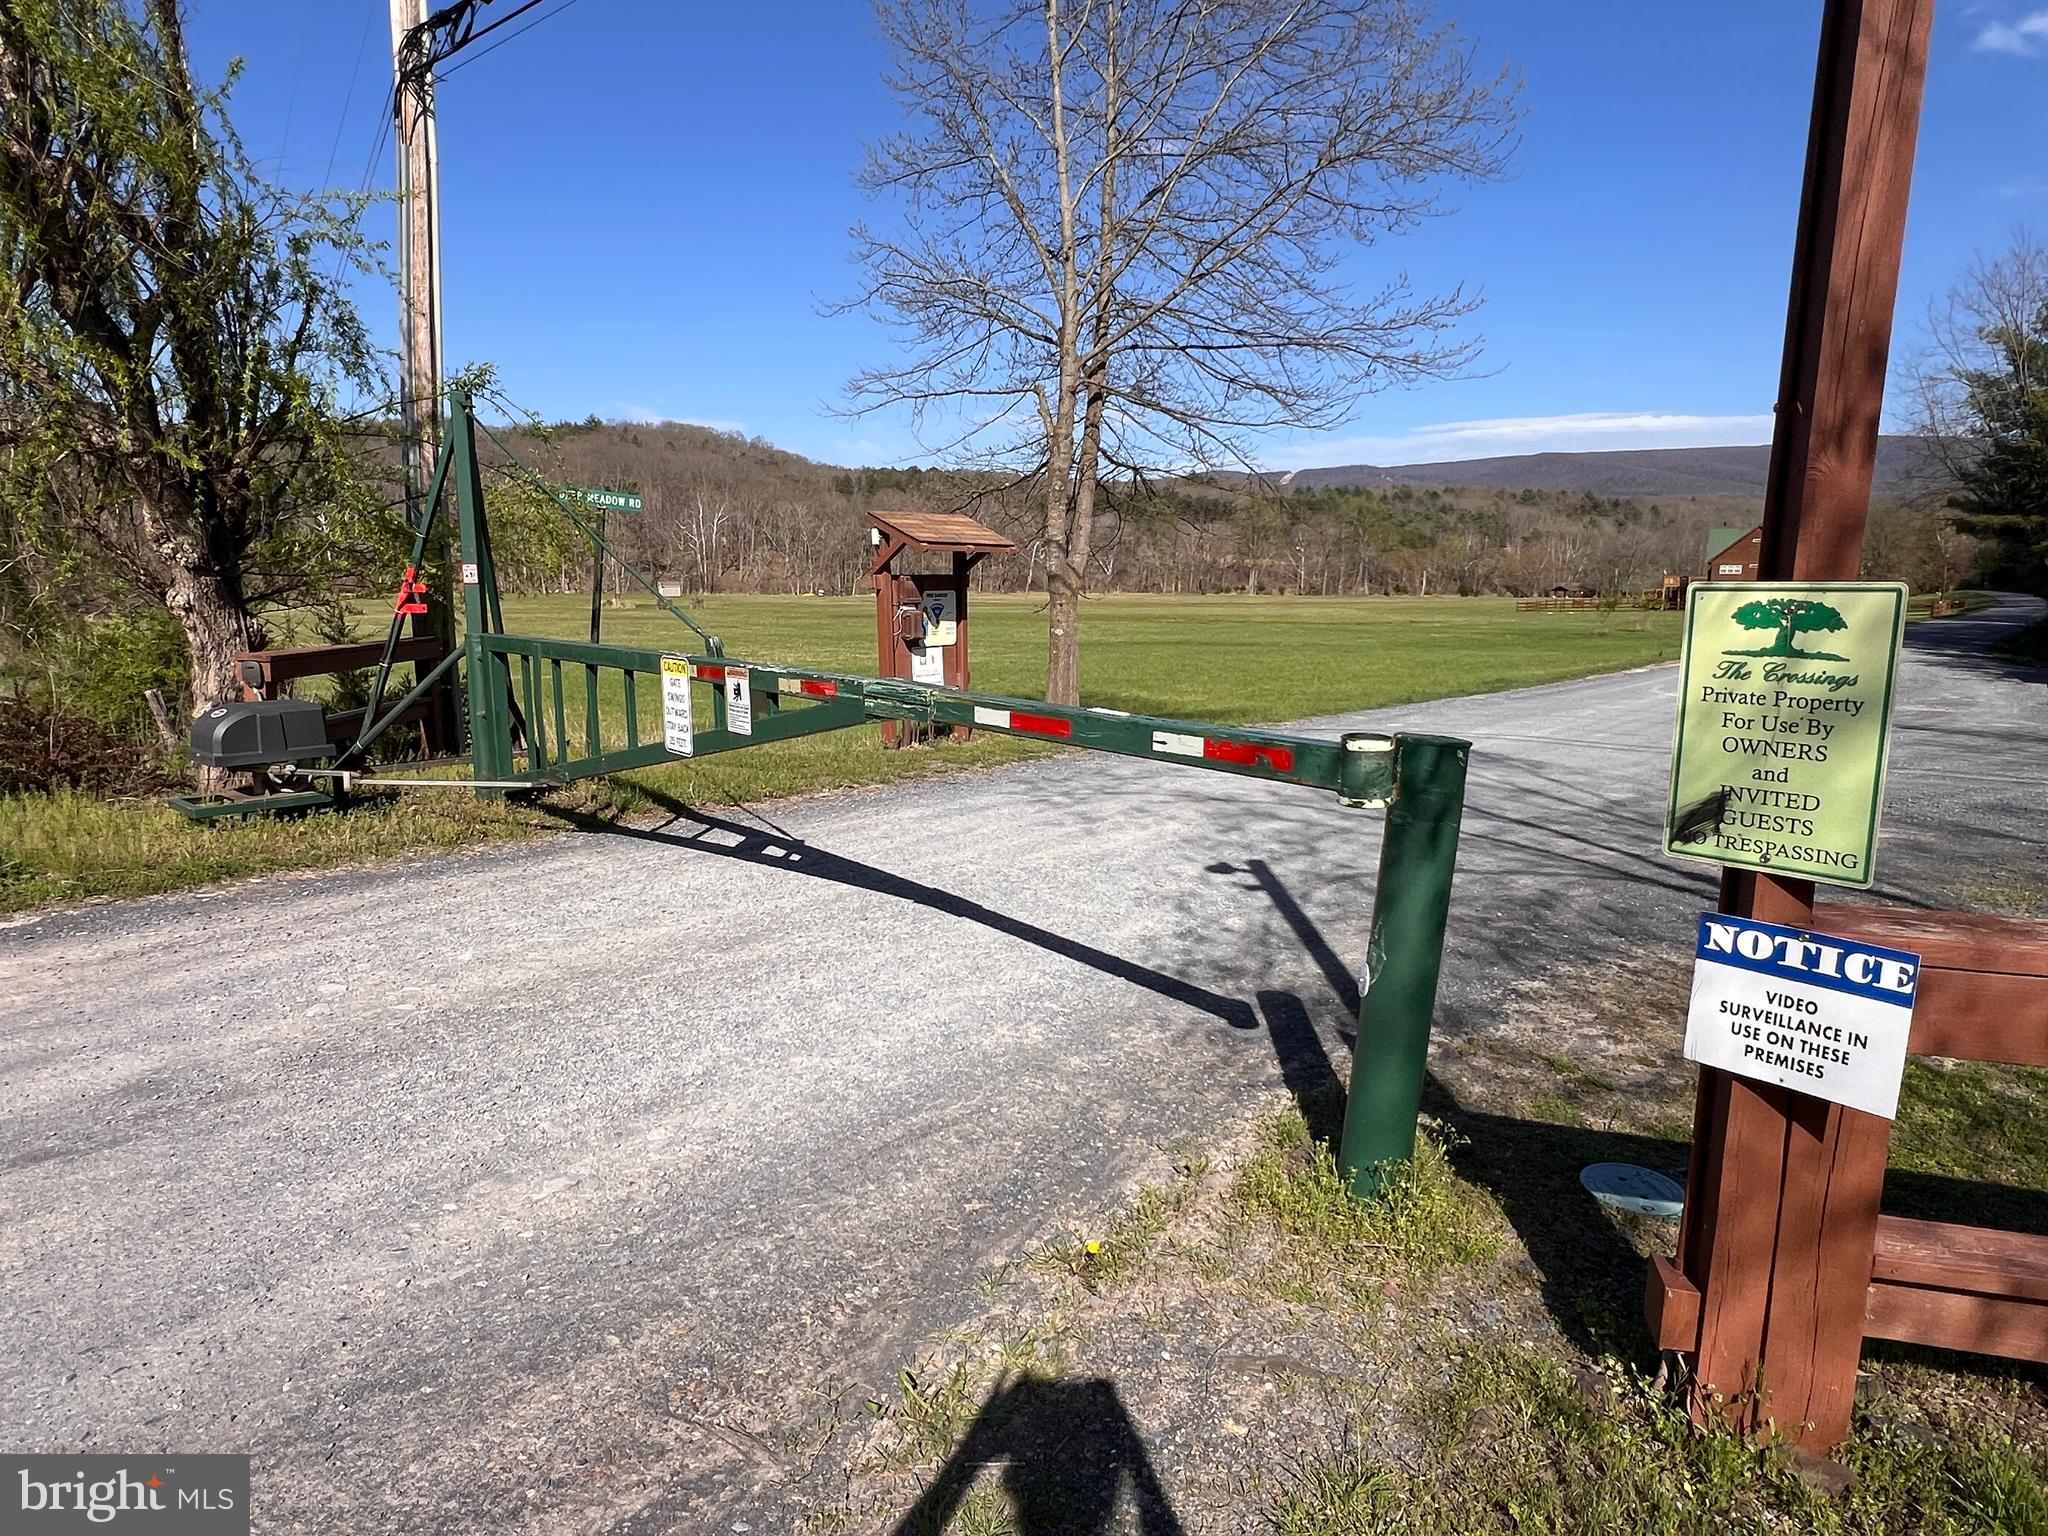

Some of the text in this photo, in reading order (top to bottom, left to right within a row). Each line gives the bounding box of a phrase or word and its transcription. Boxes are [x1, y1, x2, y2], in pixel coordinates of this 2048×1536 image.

[587, 493, 625, 506] MEADOW
[629, 498, 641, 508] RD
[663, 661, 686, 674] CAUTION
[1712, 660, 1860, 692] The Crossings
[670, 677, 681, 688] GATE
[667, 691, 685, 703] SWINGS
[1701, 686, 1864, 717] Private Property
[677, 723, 689, 733] BACK
[1721, 712, 1835, 740] For Use By
[1722, 736, 1828, 762] OWNERS
[1752, 767, 1789, 783] and
[1720, 784, 1821, 811] INVITED
[1722, 809, 1814, 836] GUESTS
[1713, 833, 1858, 869] TRESPASSING
[1704, 921, 1915, 995] NOTICE
[1766, 990, 1819, 1016] VIDEO
[1719, 1000, 1869, 1049] SURVEILLANCE IN
[1731, 1022, 1851, 1066] USE ON THESE
[1744, 1044, 1825, 1079] PREMISES
